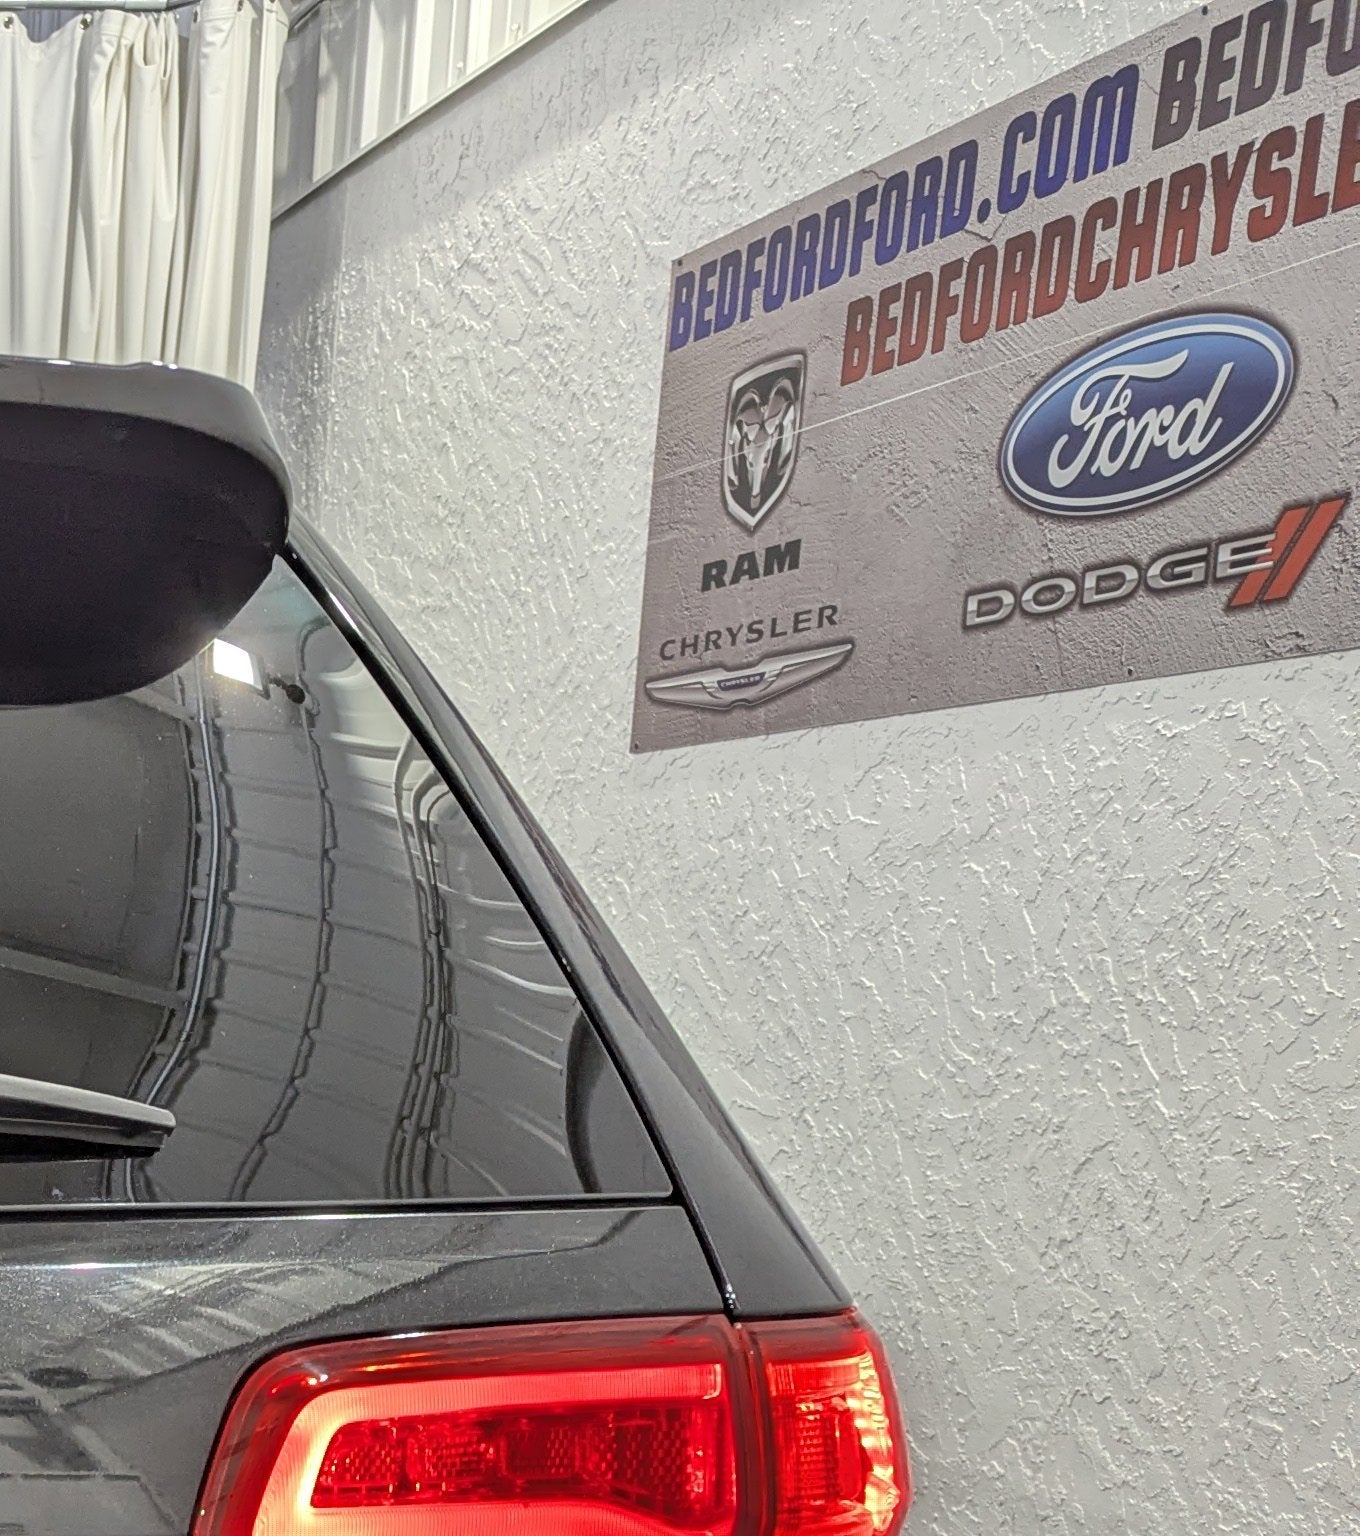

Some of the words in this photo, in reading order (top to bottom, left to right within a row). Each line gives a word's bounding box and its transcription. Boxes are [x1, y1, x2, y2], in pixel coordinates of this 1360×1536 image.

[668, 64, 1140, 353] BEDFORDFORD.COM
[1047, 347, 1235, 489] Ford
[700, 538, 802, 592] RAM
[964, 533, 1278, 631] DODGE
[659, 604, 838, 661] CHRYSLER
